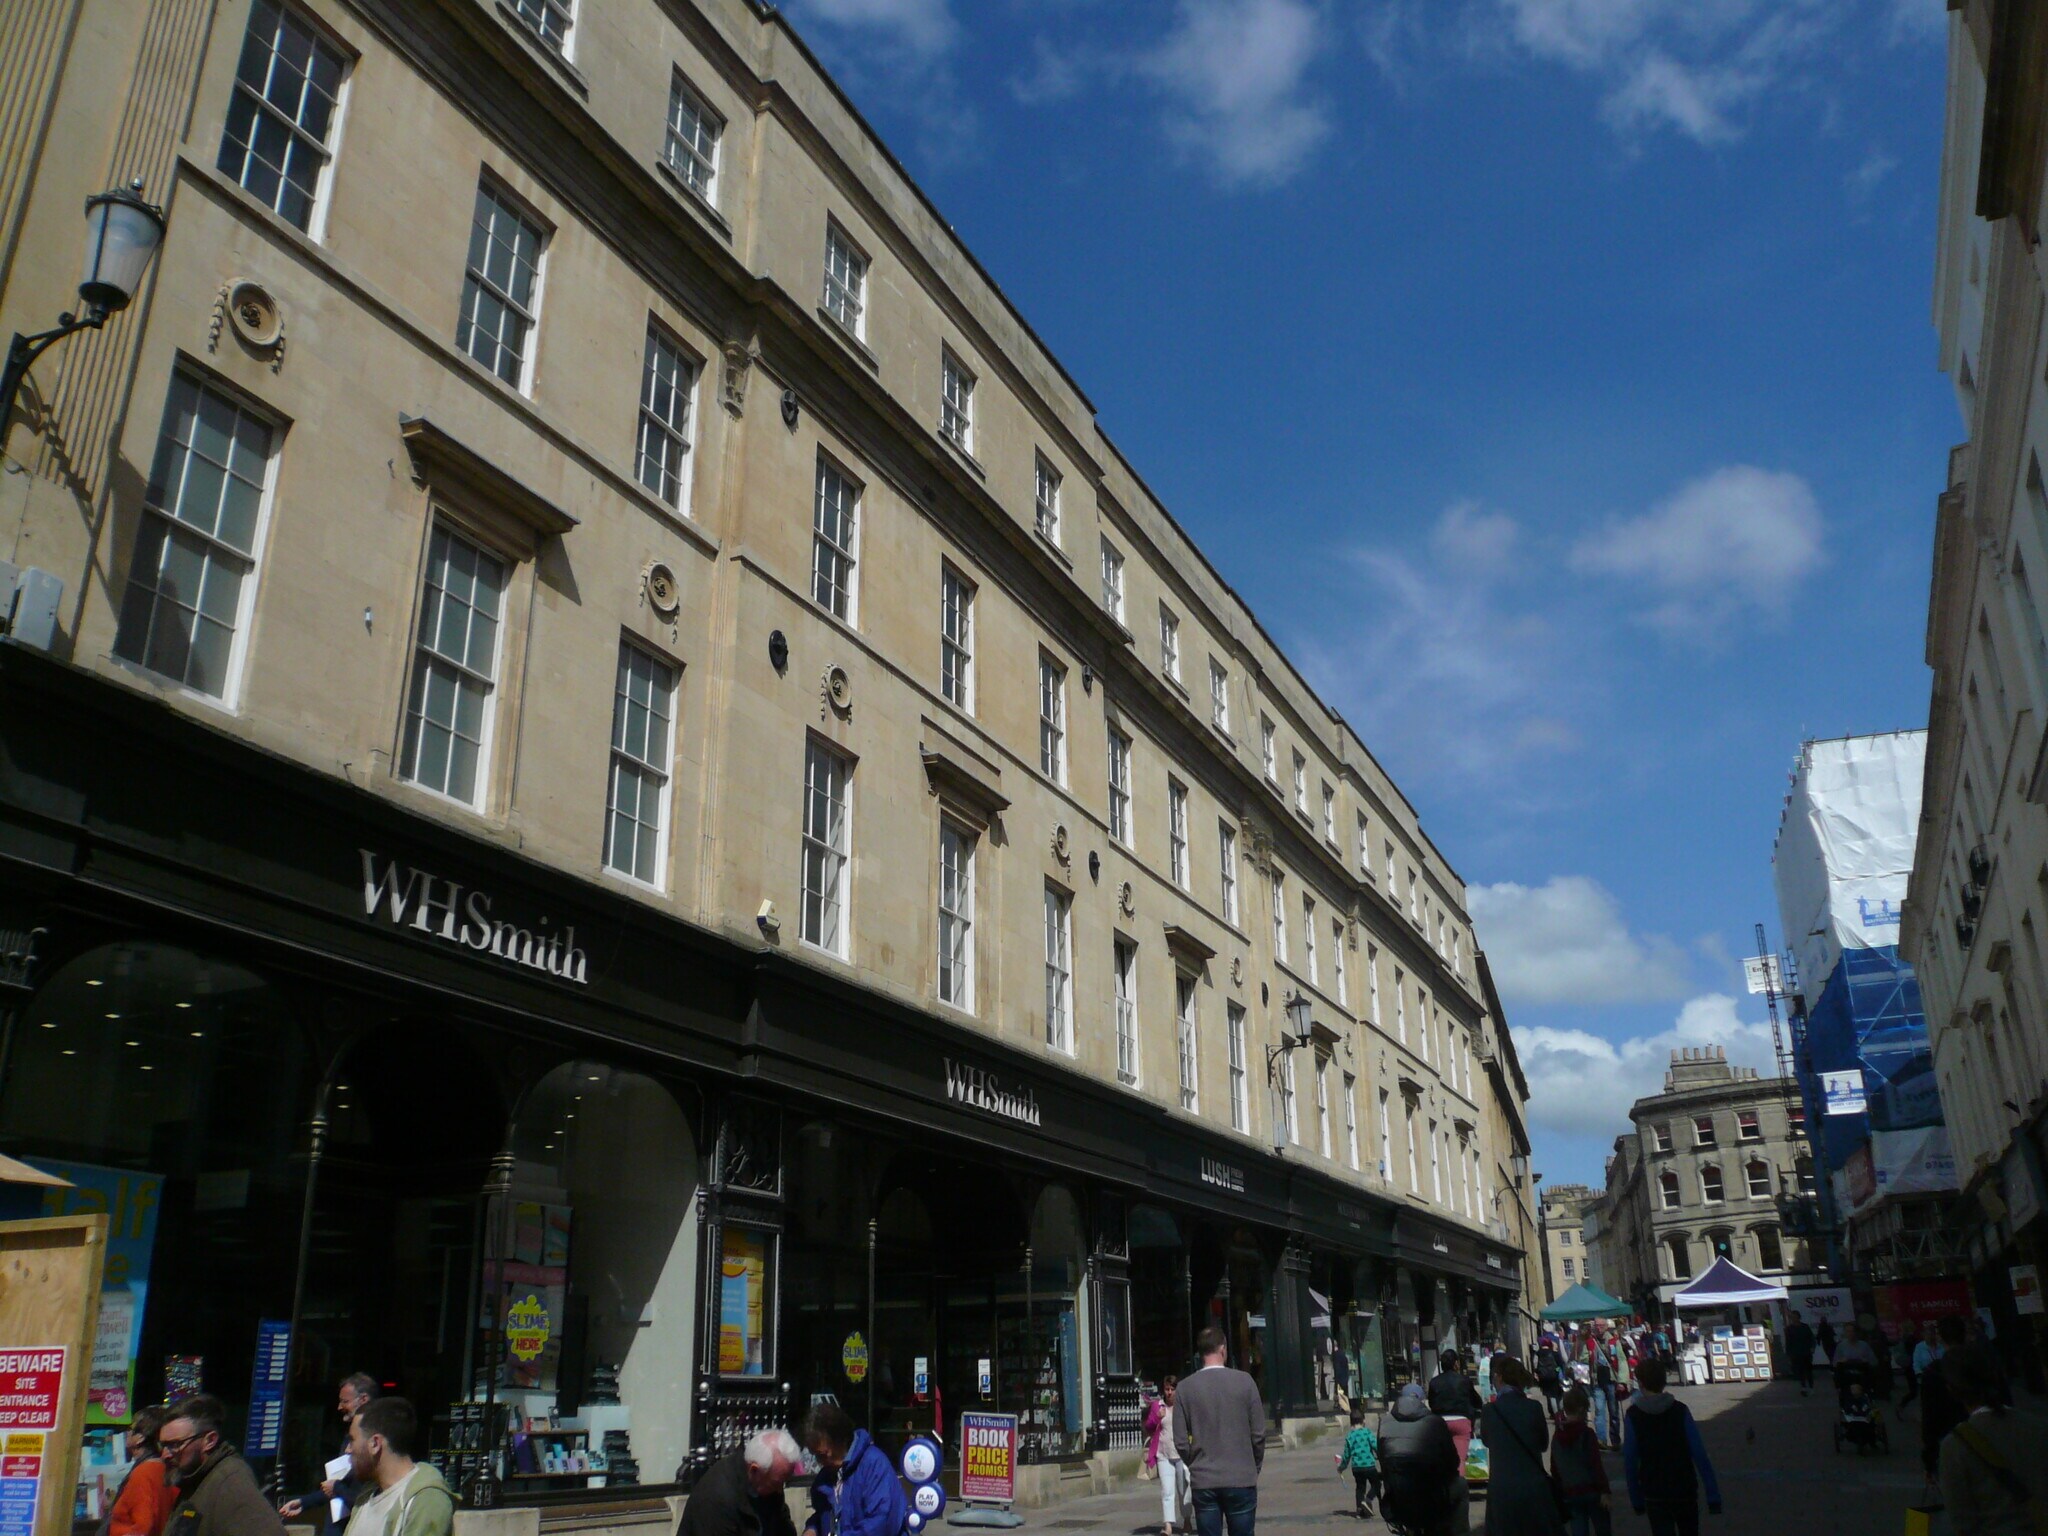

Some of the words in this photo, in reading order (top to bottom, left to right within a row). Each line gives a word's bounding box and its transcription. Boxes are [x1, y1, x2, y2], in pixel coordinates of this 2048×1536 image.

[359, 848, 588, 984] WHSmith
[943, 1056, 1041, 1126] WHSmith
[1201, 1156, 1231, 1189] LUSH
[517, 1337, 541, 1351] HERE
[0, 1353, 62, 1373] BEWARE
[15, 1377, 37, 1390] SITE
[0, 1394, 50, 1407] ENTRANCE
[105, 1392, 126, 1402] Only
[0, 1411, 17, 1424] EEP
[18, 1411, 51, 1424] CLEAR
[969, 1416, 1010, 1428] WHSmith
[968, 1428, 1009, 1448] BOOK
[967, 1446, 1009, 1465] PRICE
[967, 1464, 1009, 1478] PROMISE
